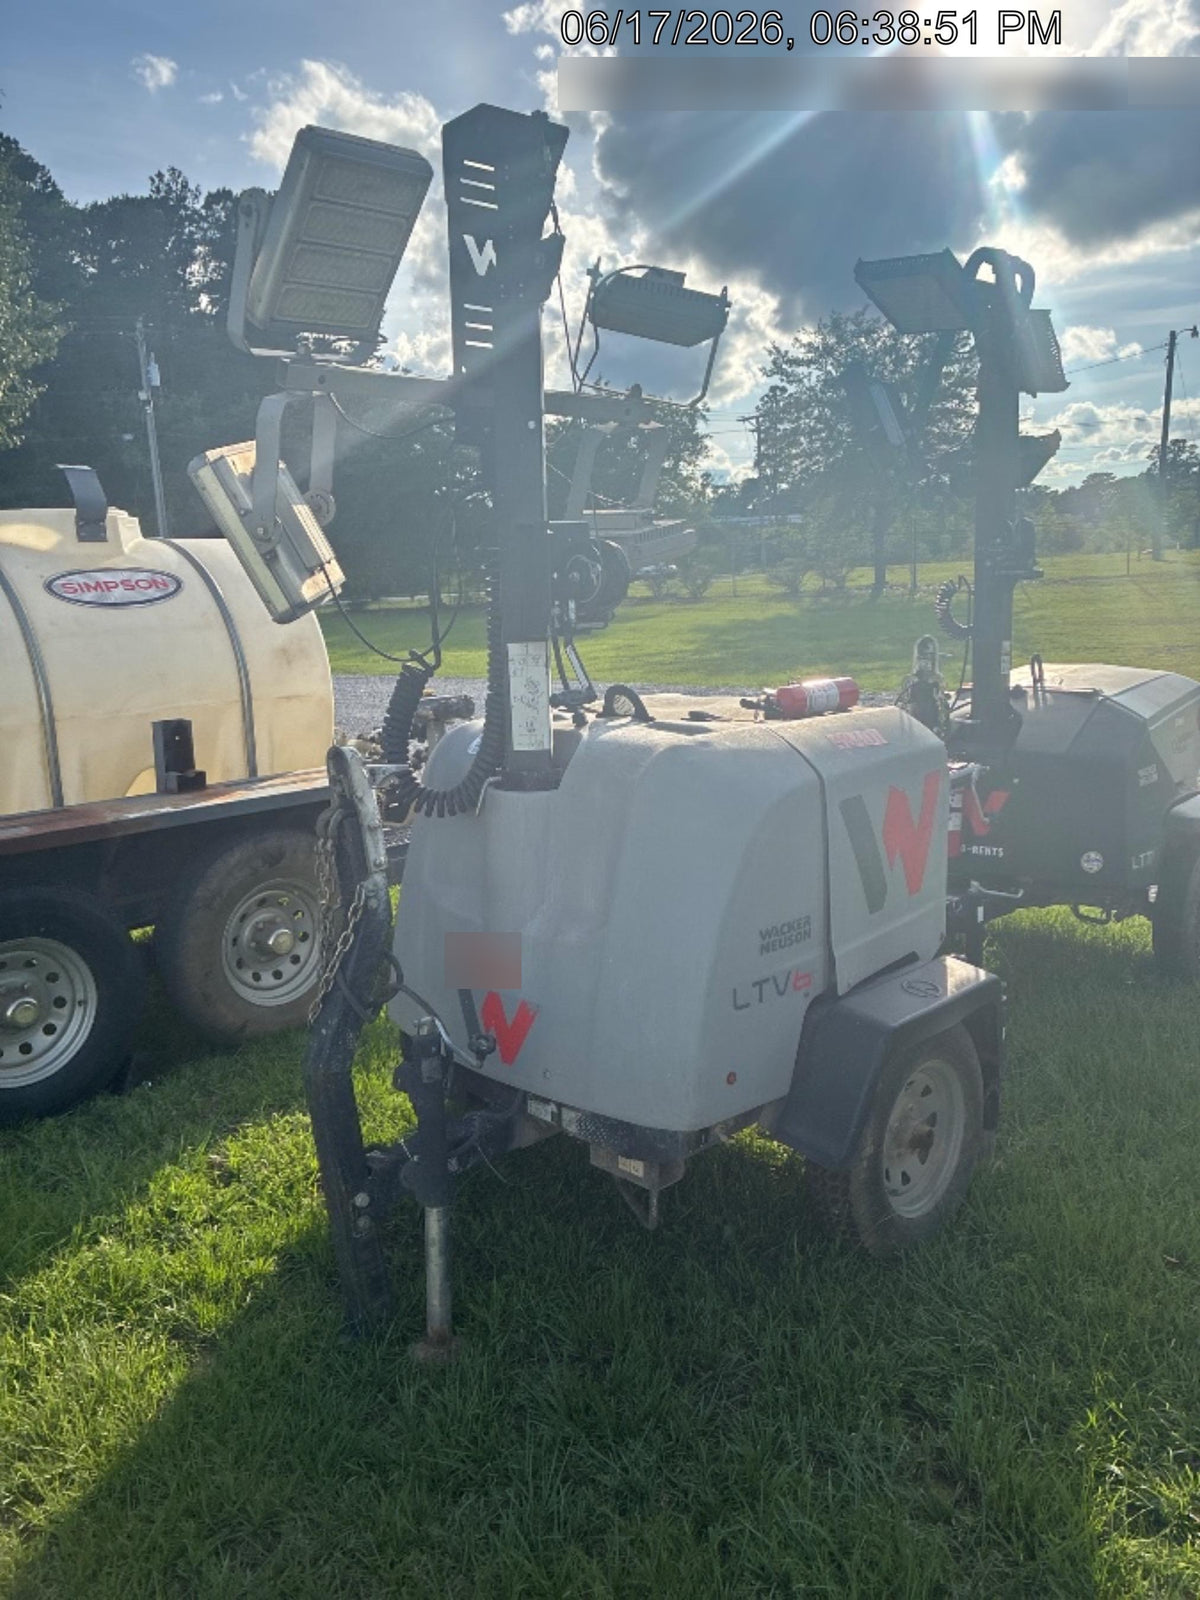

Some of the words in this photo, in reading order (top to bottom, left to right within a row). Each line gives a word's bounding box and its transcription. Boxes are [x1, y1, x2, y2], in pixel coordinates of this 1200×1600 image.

[60, 577, 170, 595] SIMPSON
[759, 915, 811, 942] WACKER
[759, 928, 811, 956] NEUSON
[732, 970, 813, 1011] LTV6
